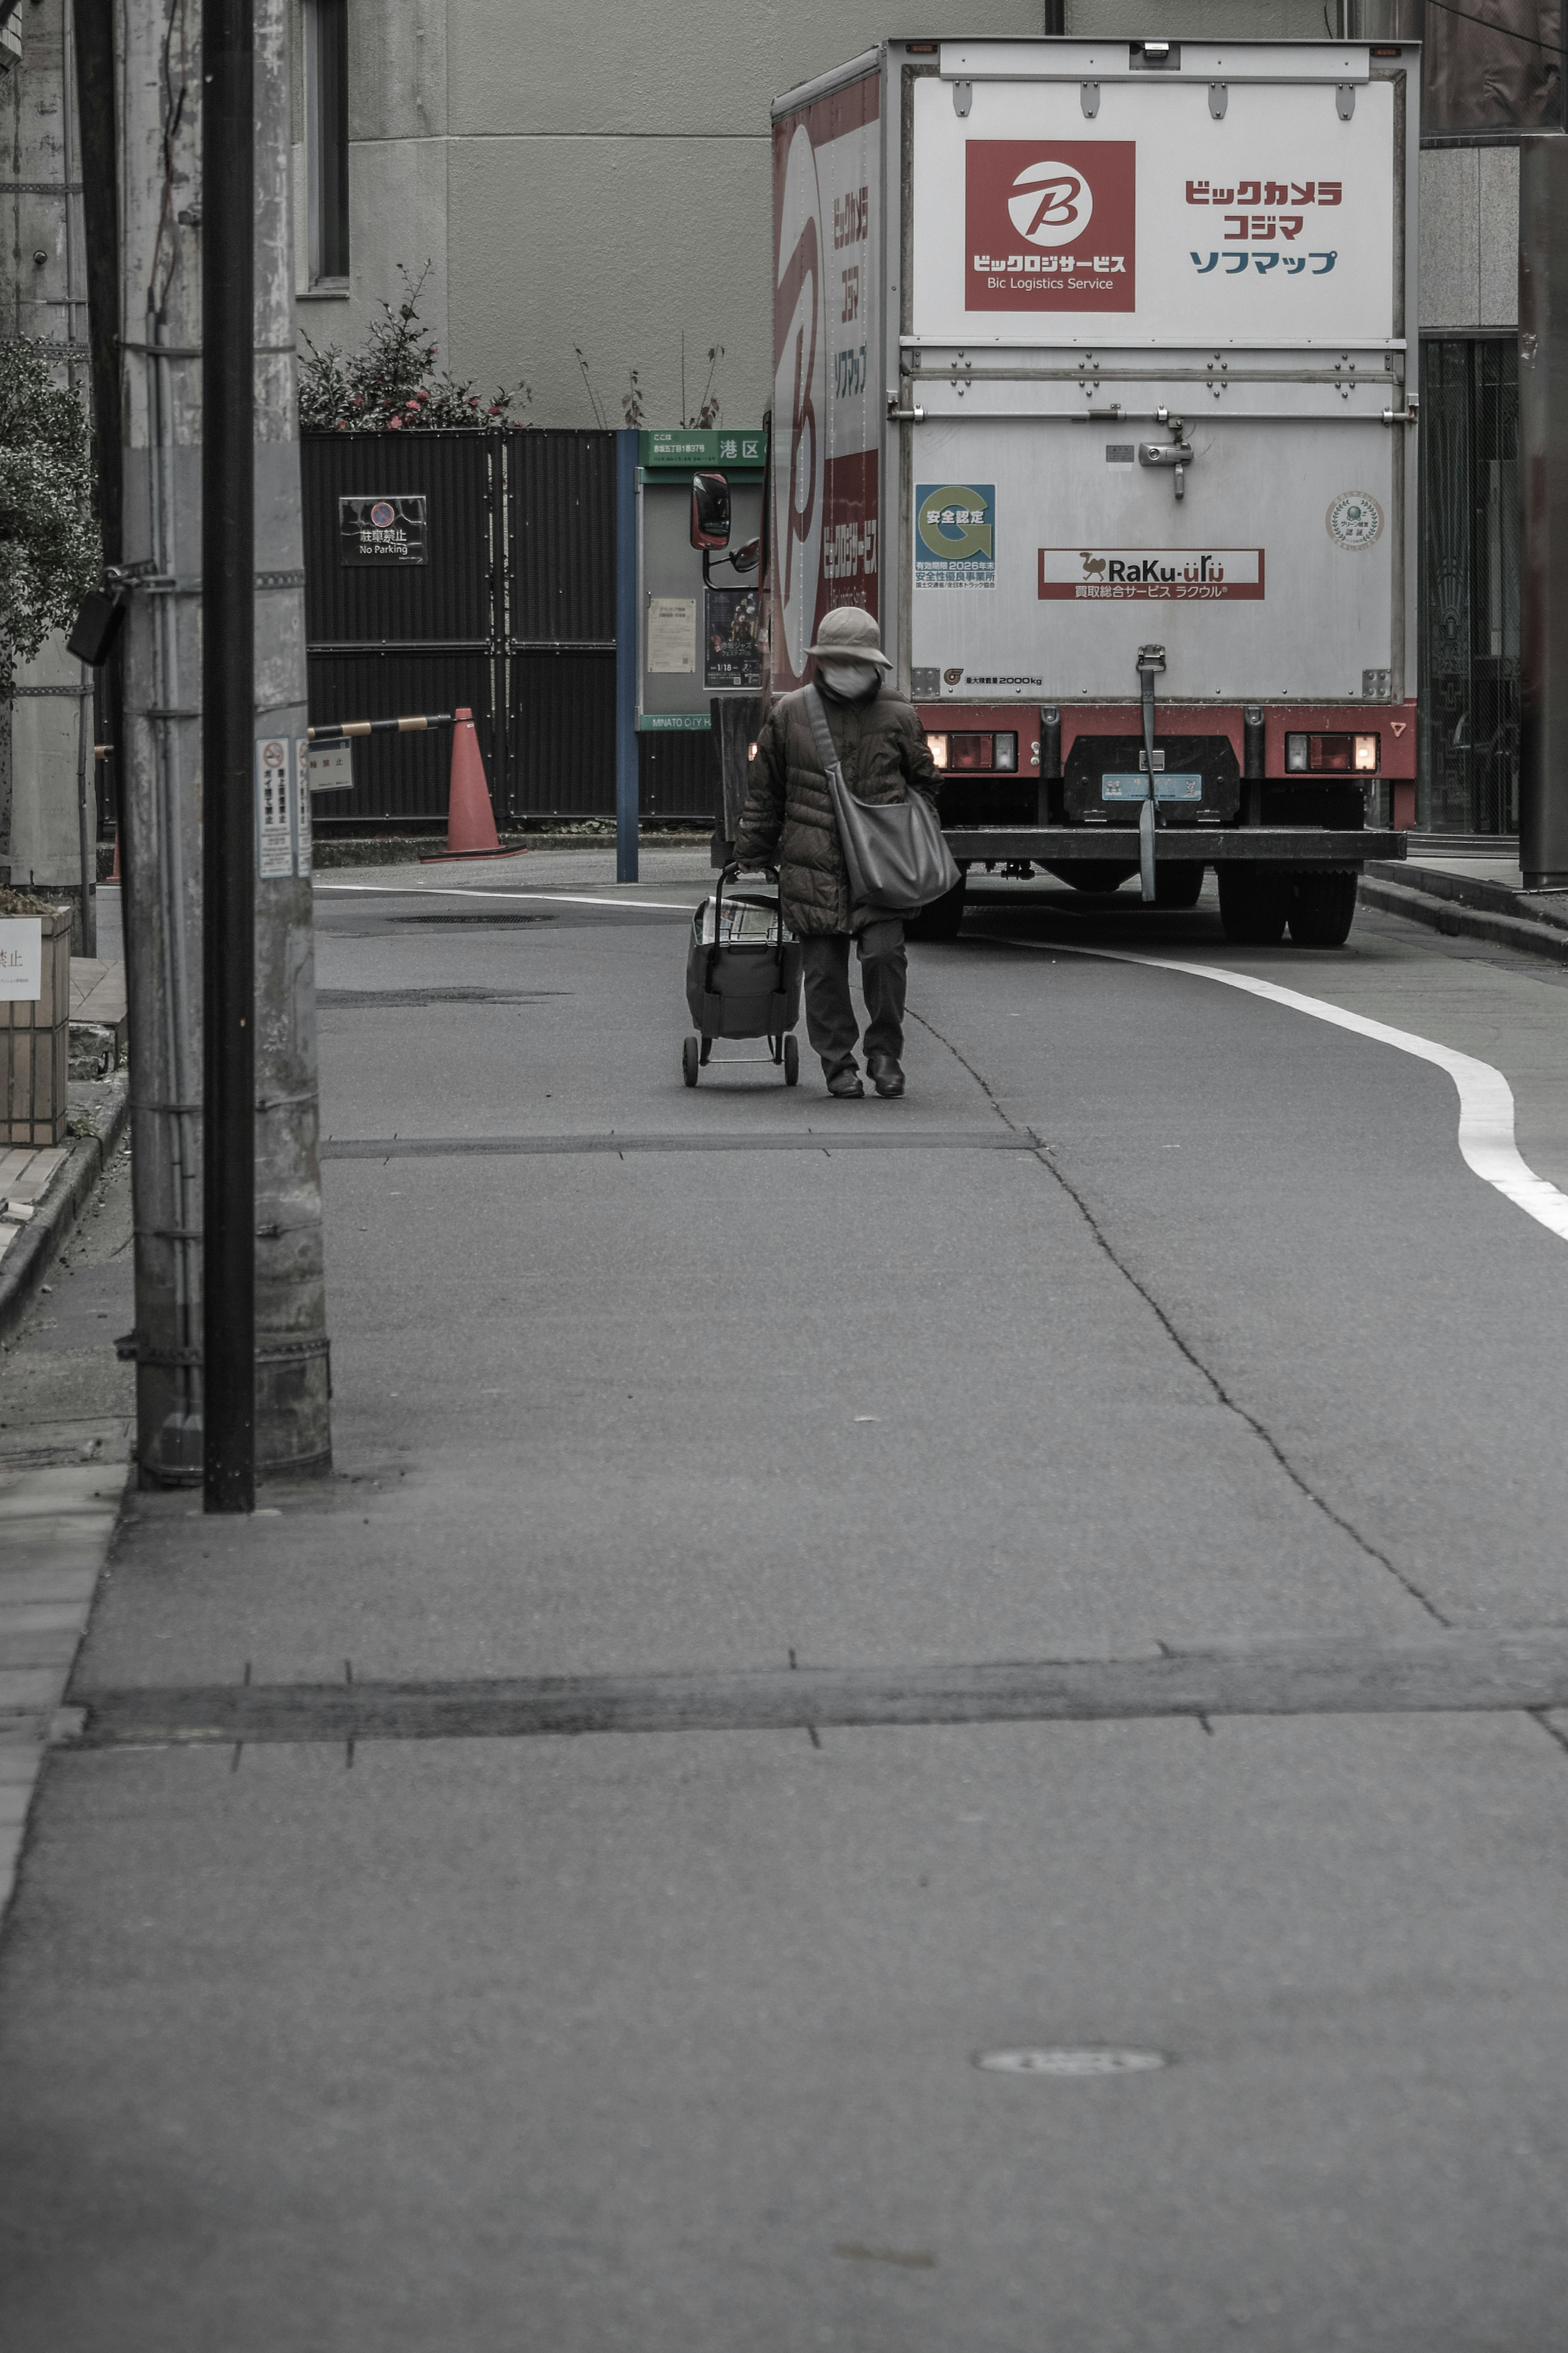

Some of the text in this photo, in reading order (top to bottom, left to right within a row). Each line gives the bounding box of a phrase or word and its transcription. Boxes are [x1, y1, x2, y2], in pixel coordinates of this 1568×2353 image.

[1186, 181, 1342, 206] ビックカメラ
[834, 186, 869, 250] ビックカメラ
[1224, 216, 1303, 240] コジマ
[974, 255, 1127, 272] ビックロジサービス
[1189, 251, 1338, 274] ソフマップ
[988, 277, 1113, 291] Bic Logistics Service
[842, 266, 859, 323] コジマ
[834, 341, 867, 400] ソフマップ
[720, 439, 759, 459] 港区
[927, 510, 984, 524] 安全認定
[360, 529, 407, 542] 駐車禁止
[359, 545, 408, 555] No Parking
[824, 520, 877, 578] ビックロジサービス
[916, 571, 995, 581] 安全性優良事業所
[1075, 585, 1171, 598] 買取総合サービス
[653, 718, 682, 727] MINATO
